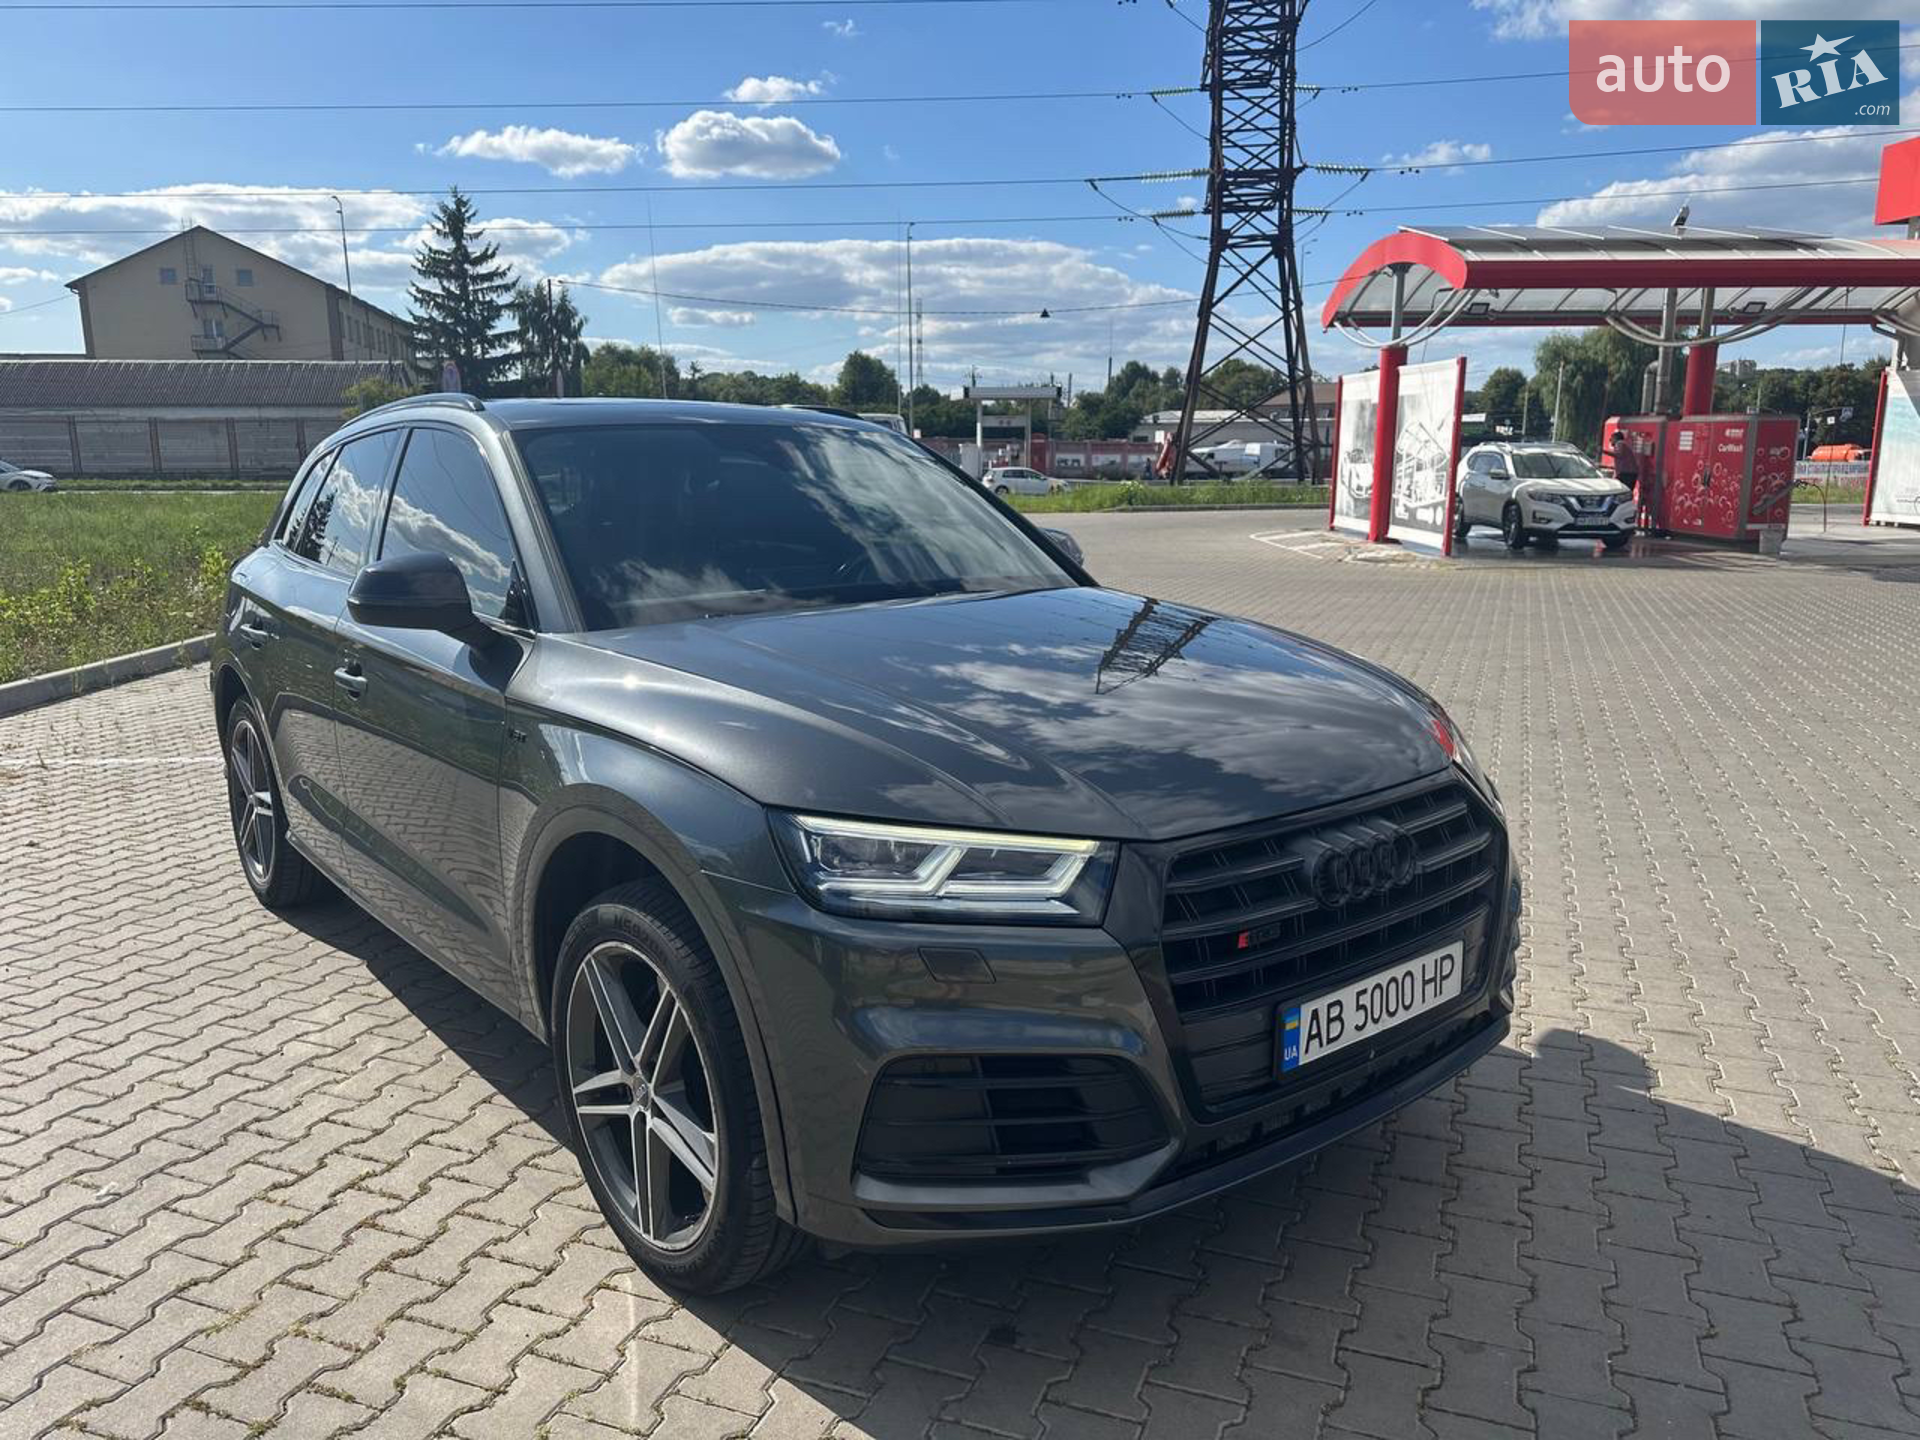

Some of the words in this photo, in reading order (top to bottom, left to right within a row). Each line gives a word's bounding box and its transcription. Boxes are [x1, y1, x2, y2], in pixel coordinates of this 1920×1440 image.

[1304, 999, 1345, 1055] AB
[1354, 970, 1414, 1032] 5000
[1421, 953, 1455, 1005] HP
[1284, 1045, 1298, 1060] UA
